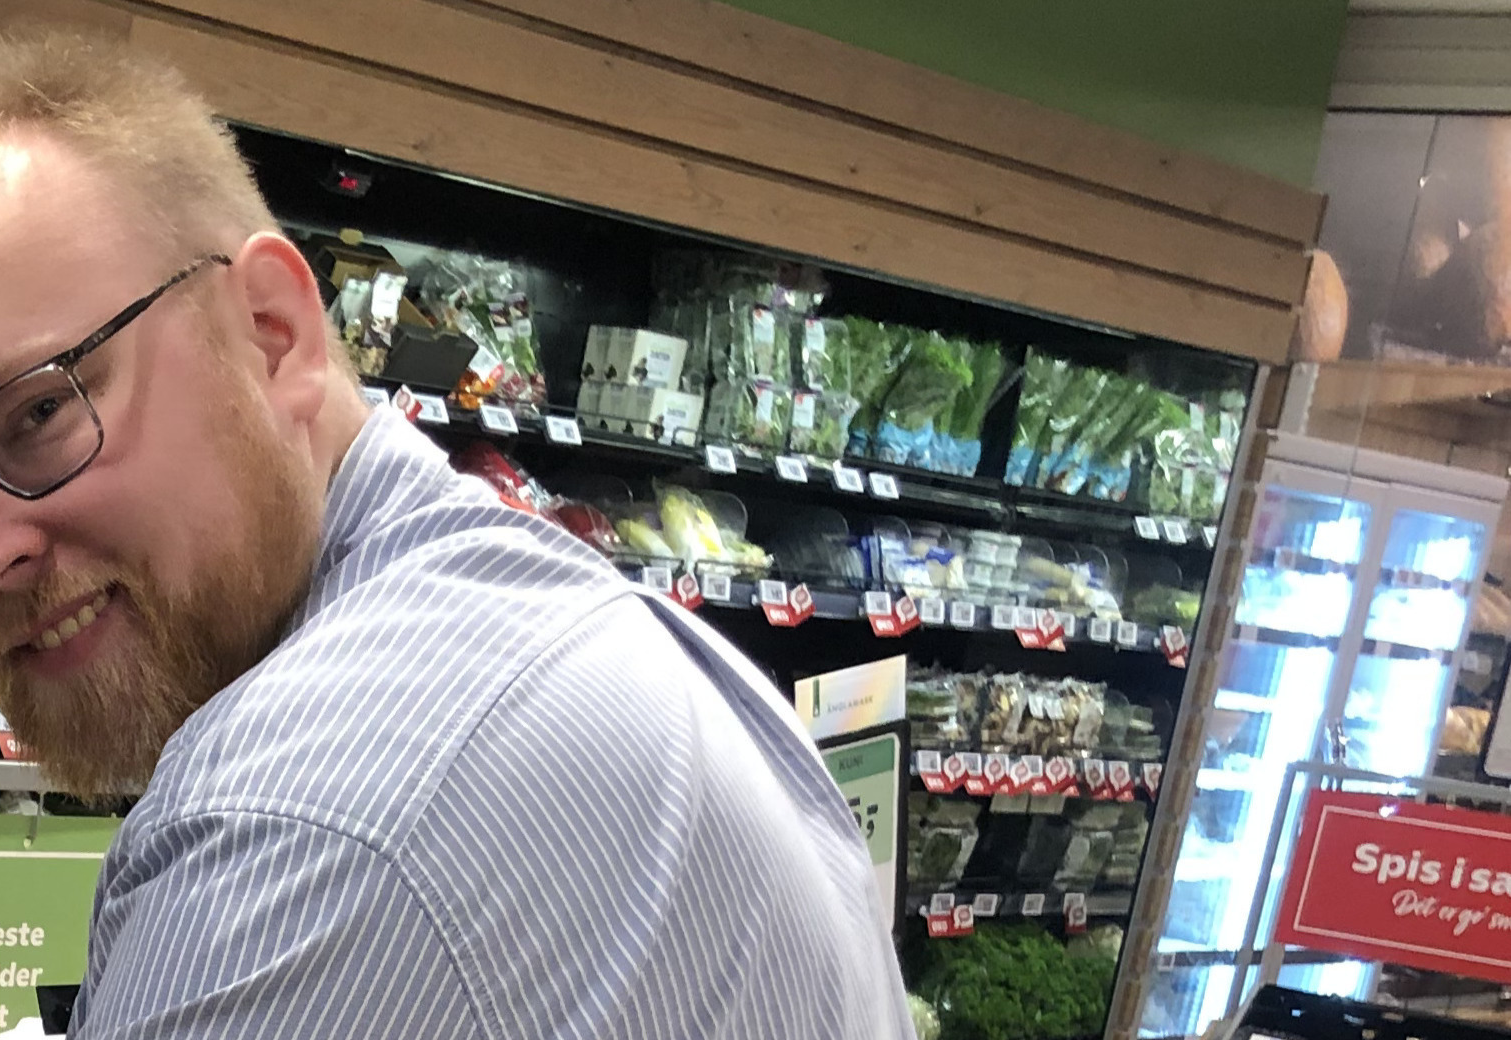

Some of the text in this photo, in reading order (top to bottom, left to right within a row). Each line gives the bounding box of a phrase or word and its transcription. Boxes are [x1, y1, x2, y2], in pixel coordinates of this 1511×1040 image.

[1352, 843, 1442, 885] Spis
[1451, 857, 1466, 888] i
[1392, 889, 1437, 918] Det
